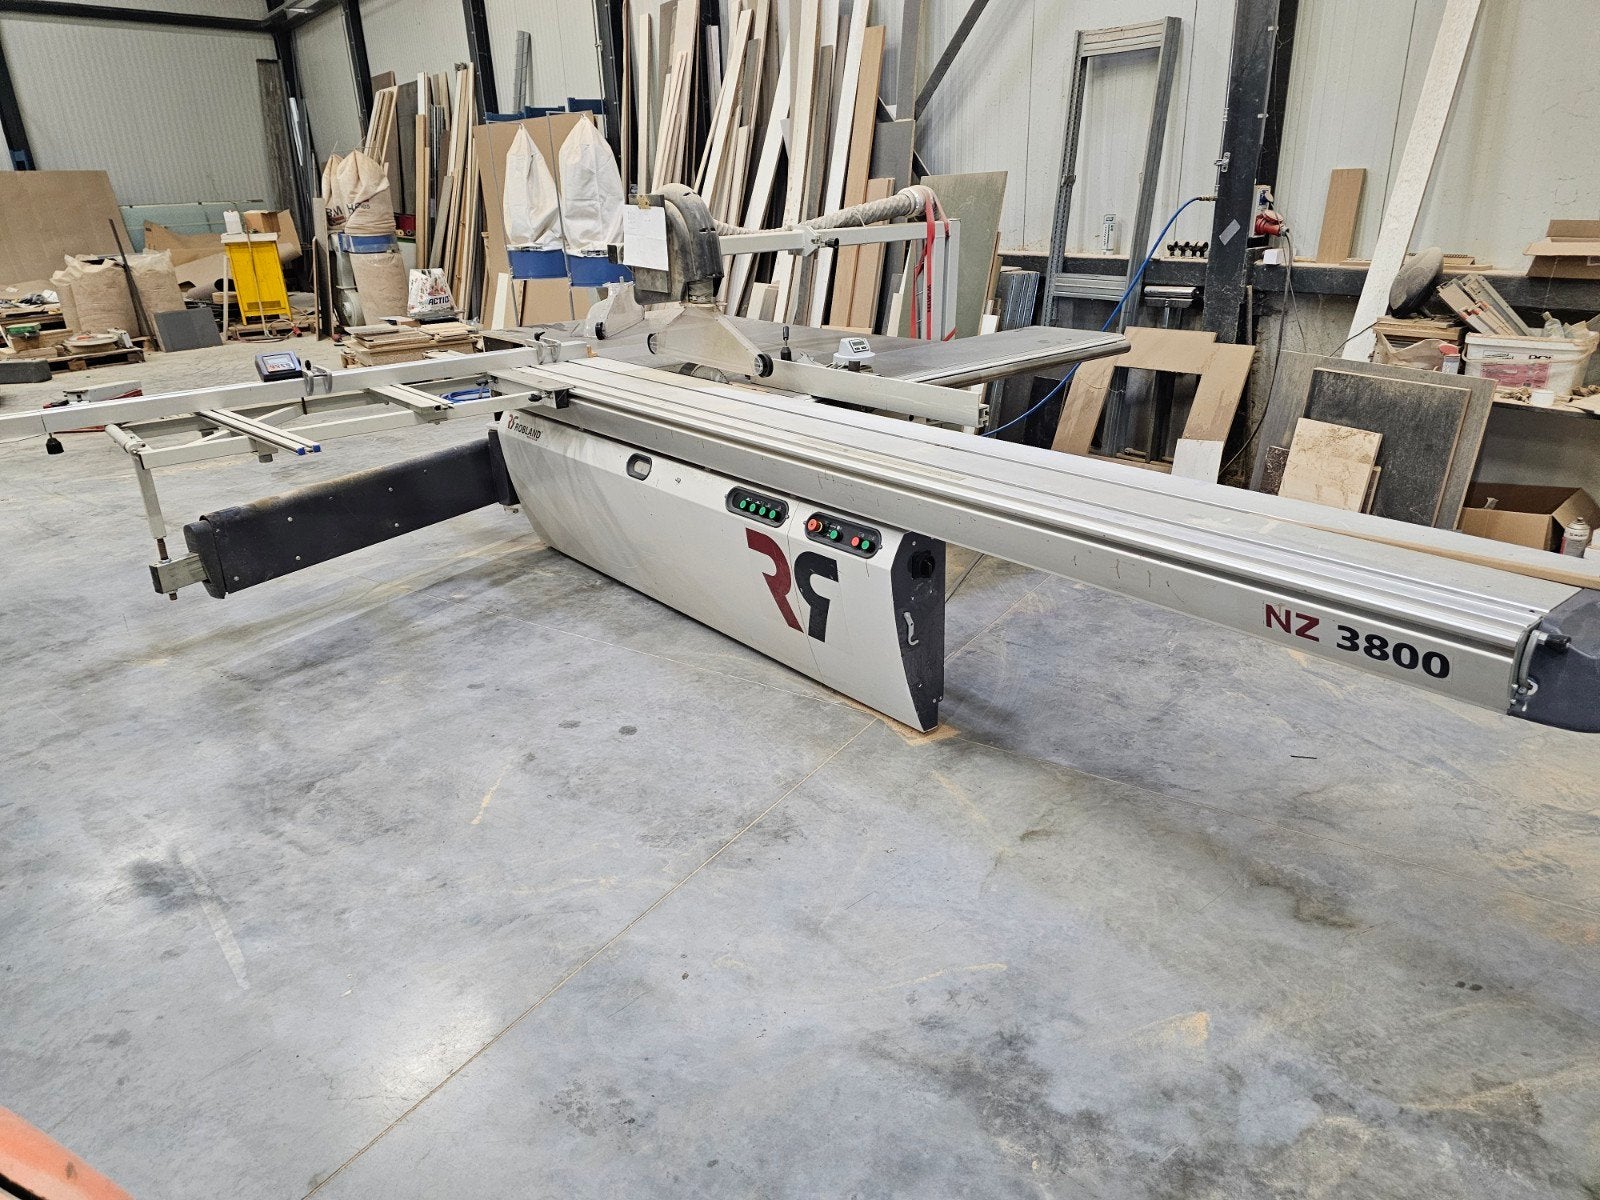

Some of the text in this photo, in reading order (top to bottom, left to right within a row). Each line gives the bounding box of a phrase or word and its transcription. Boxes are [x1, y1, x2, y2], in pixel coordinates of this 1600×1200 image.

[513, 422, 542, 439] ROBLAND
[1265, 603, 1450, 679] NZ 3800
